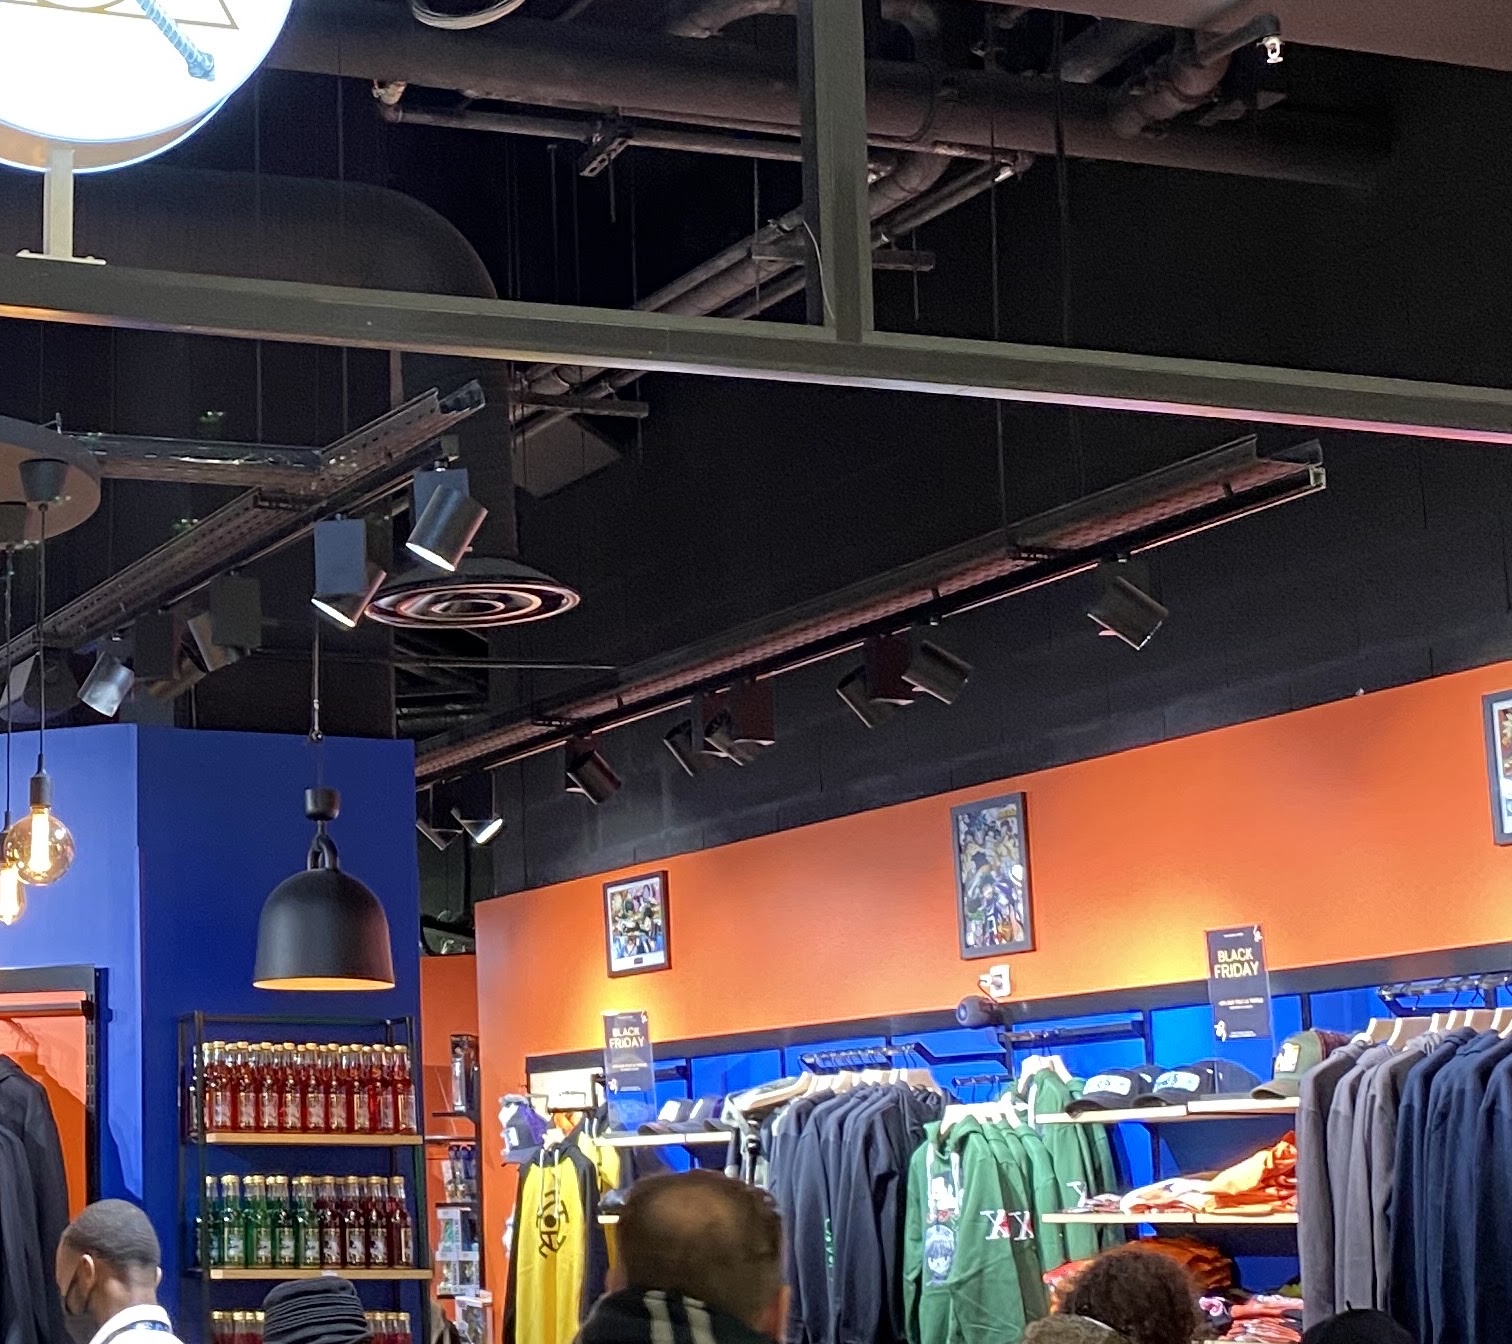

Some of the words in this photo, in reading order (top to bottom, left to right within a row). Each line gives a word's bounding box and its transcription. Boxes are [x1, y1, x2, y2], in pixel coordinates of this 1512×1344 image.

[1216, 947, 1254, 962] BLACK
[1213, 960, 1260, 979] FRIDAY
[611, 1026, 641, 1037] BLACK
[608, 1036, 645, 1049] FRIDAY
